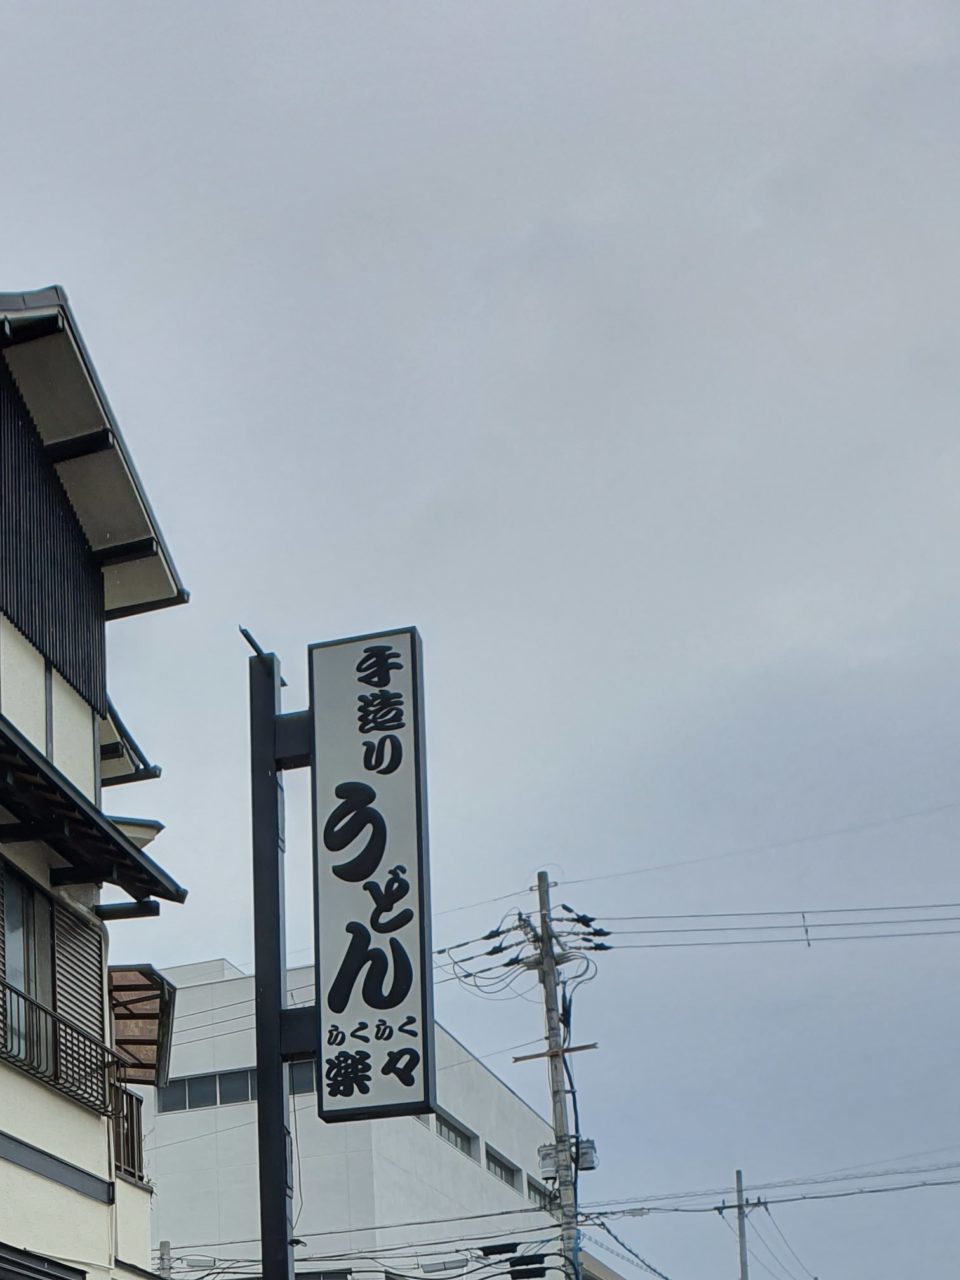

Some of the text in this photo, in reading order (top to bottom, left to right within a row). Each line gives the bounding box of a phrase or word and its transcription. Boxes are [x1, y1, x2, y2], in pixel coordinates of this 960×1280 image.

[356, 645, 405, 775] 手造り
[323, 781, 414, 1014] うどん
[327, 1015, 419, 1047] らくらく
